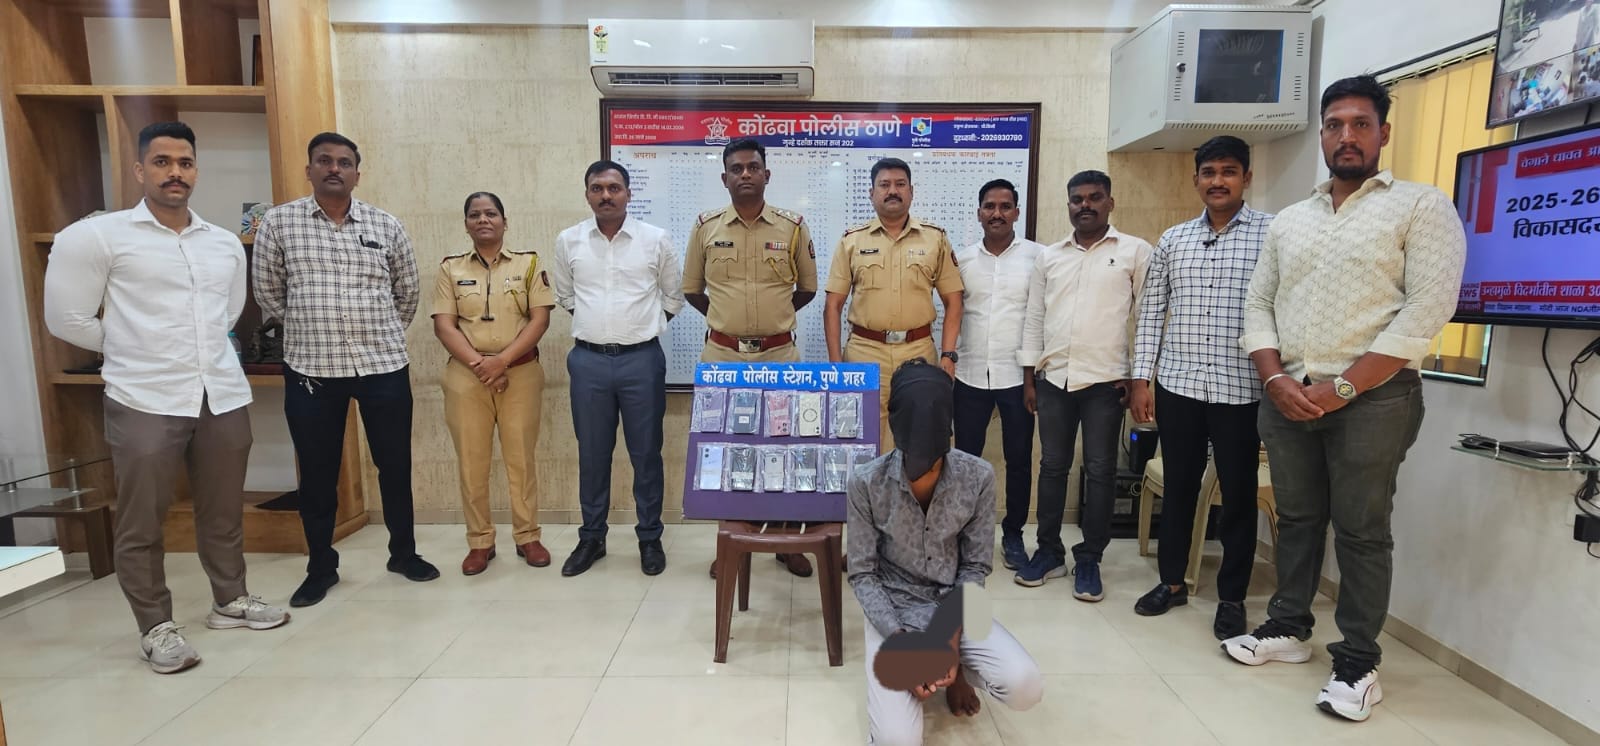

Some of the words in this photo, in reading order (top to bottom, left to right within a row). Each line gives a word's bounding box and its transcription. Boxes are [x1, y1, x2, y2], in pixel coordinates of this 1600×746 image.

[737, 114, 796, 136] कोंढवा
[800, 114, 861, 137] पोलीस
[864, 115, 902, 137] ठाणे
[1521, 153, 1550, 169] वेगाने
[1552, 149, 1583, 164] धावत
[1459, 288, 1478, 298] EWS
[1514, 281, 1557, 297] विदर्भातील
[1560, 285, 1585, 297] शाळा
[702, 365, 737, 383] कोंढवा
[743, 365, 778, 384] पोलीस
[783, 366, 817, 387] स्टेशन,
[820, 366, 838, 390] पुणे
[843, 370, 866, 387] शहर
